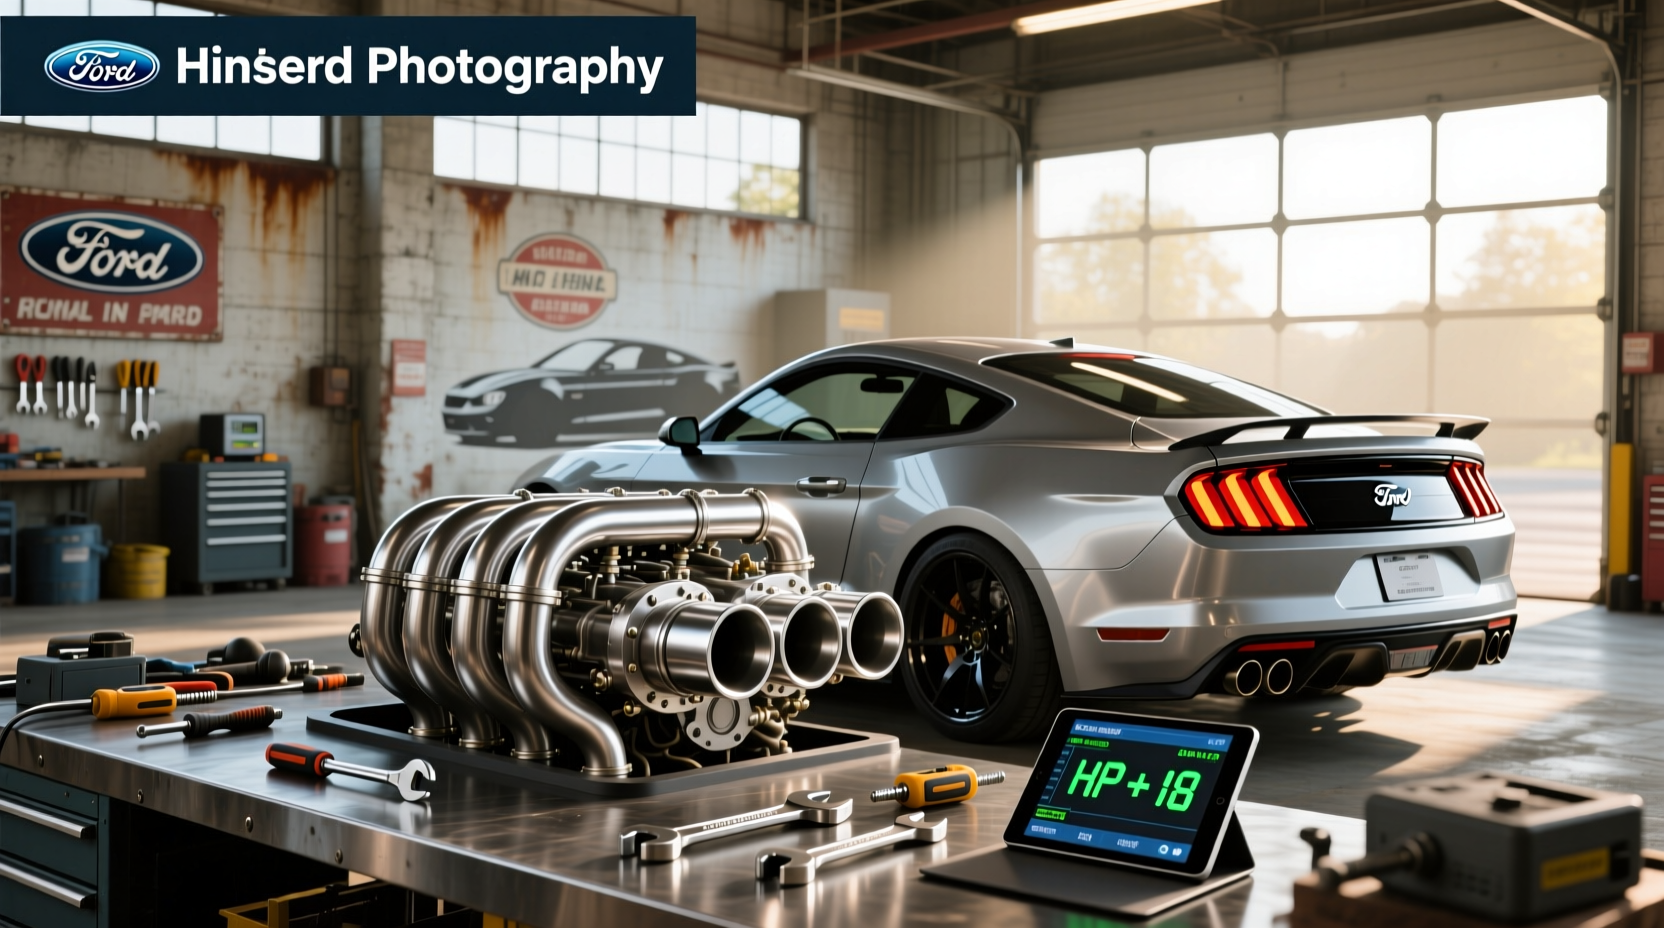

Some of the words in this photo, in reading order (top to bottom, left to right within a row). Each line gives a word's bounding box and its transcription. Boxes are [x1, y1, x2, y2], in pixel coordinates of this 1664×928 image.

[56, 220, 172, 281] Ford
[102, 301, 129, 324] IN
[1066, 758, 1127, 798] HP
[1154, 770, 1202, 812] 18
